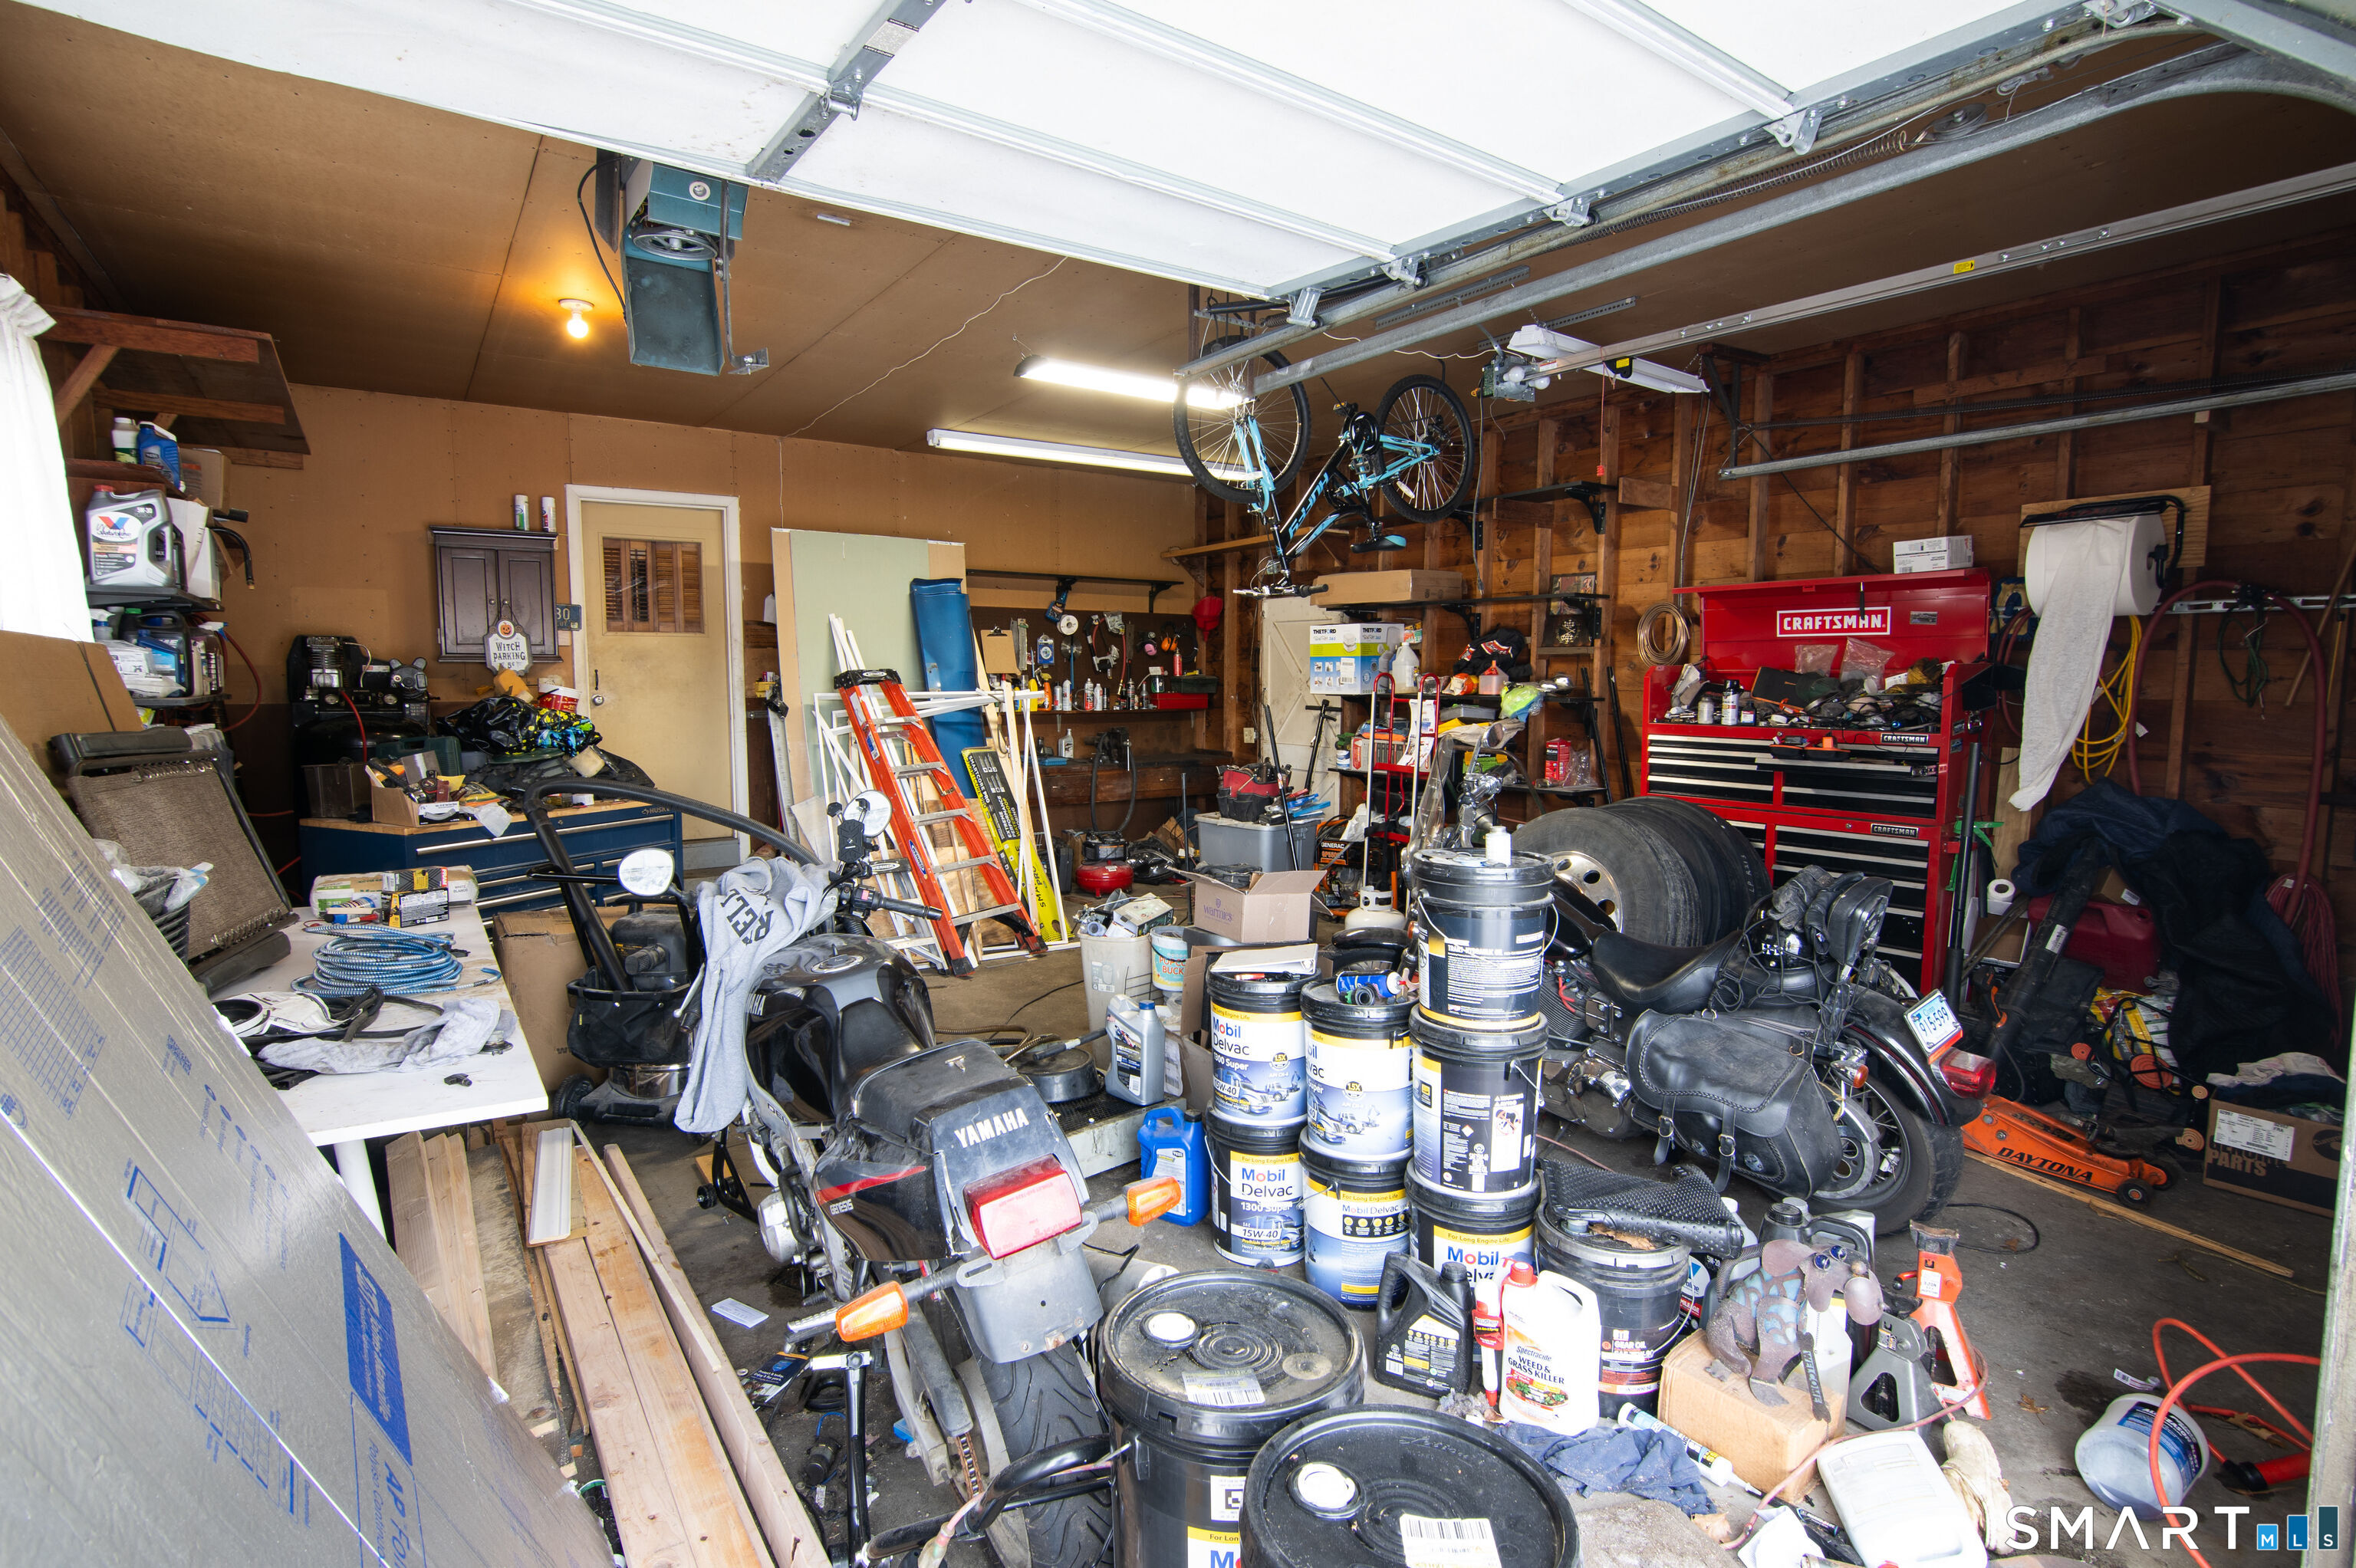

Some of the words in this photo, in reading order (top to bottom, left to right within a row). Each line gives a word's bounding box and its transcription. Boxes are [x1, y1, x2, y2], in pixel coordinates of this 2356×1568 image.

[1288, 472, 1329, 539] HUFFY
[1782, 613, 1883, 631] CRAFTSMAN
[495, 641, 521, 652] WITCH
[493, 652, 526, 662] PARKING
[1882, 734, 1927, 744] CRAFTSMAN
[967, 754, 986, 791] SMARTCORE
[982, 788, 991, 804] PRO
[997, 795, 1017, 838] PERFORMANCE
[999, 811, 1013, 839] EXTREME
[1873, 825, 1916, 837] CRAFTSMAN
[1203, 904, 1233, 922] warmies
[1225, 1011, 1239, 1020] Engine
[1213, 1016, 1242, 1039] Mobil
[1213, 1032, 1250, 1056] Delvac
[1226, 1057, 1249, 1071] Super
[1214, 1080, 1237, 1096] 15W-40
[953, 1106, 1030, 1149] YAMAHA
[1996, 1146, 2094, 1182] DAYTONA
[2206, 1150, 2268, 1178] PARTS
[1242, 1167, 1285, 1182] Mobil
[1242, 1183, 1293, 1198] Delvac
[829, 1198, 854, 1216] GENESIS
[1240, 1201, 1264, 1212] 1300
[1342, 1204, 1369, 1215] Mobil
[1370, 1204, 1399, 1215] Delvac
[1242, 1228, 1279, 1239] 15W-40
[1459, 1235, 1476, 1244] Long
[1447, 1245, 1499, 1266] Mobil
[1680, 1297, 1700, 1314] MILEGE
[1516, 1345, 1552, 1363] Spectracide
[1508, 1356, 1533, 1376] GRASS
[1535, 1370, 1565, 1385] KILLER
[1518, 1354, 1543, 1372] WEED
[1544, 1365, 1551, 1374] &
[1802, 1349, 1824, 1405] WELCOME
[1224, 1534, 1239, 1543] Lon
